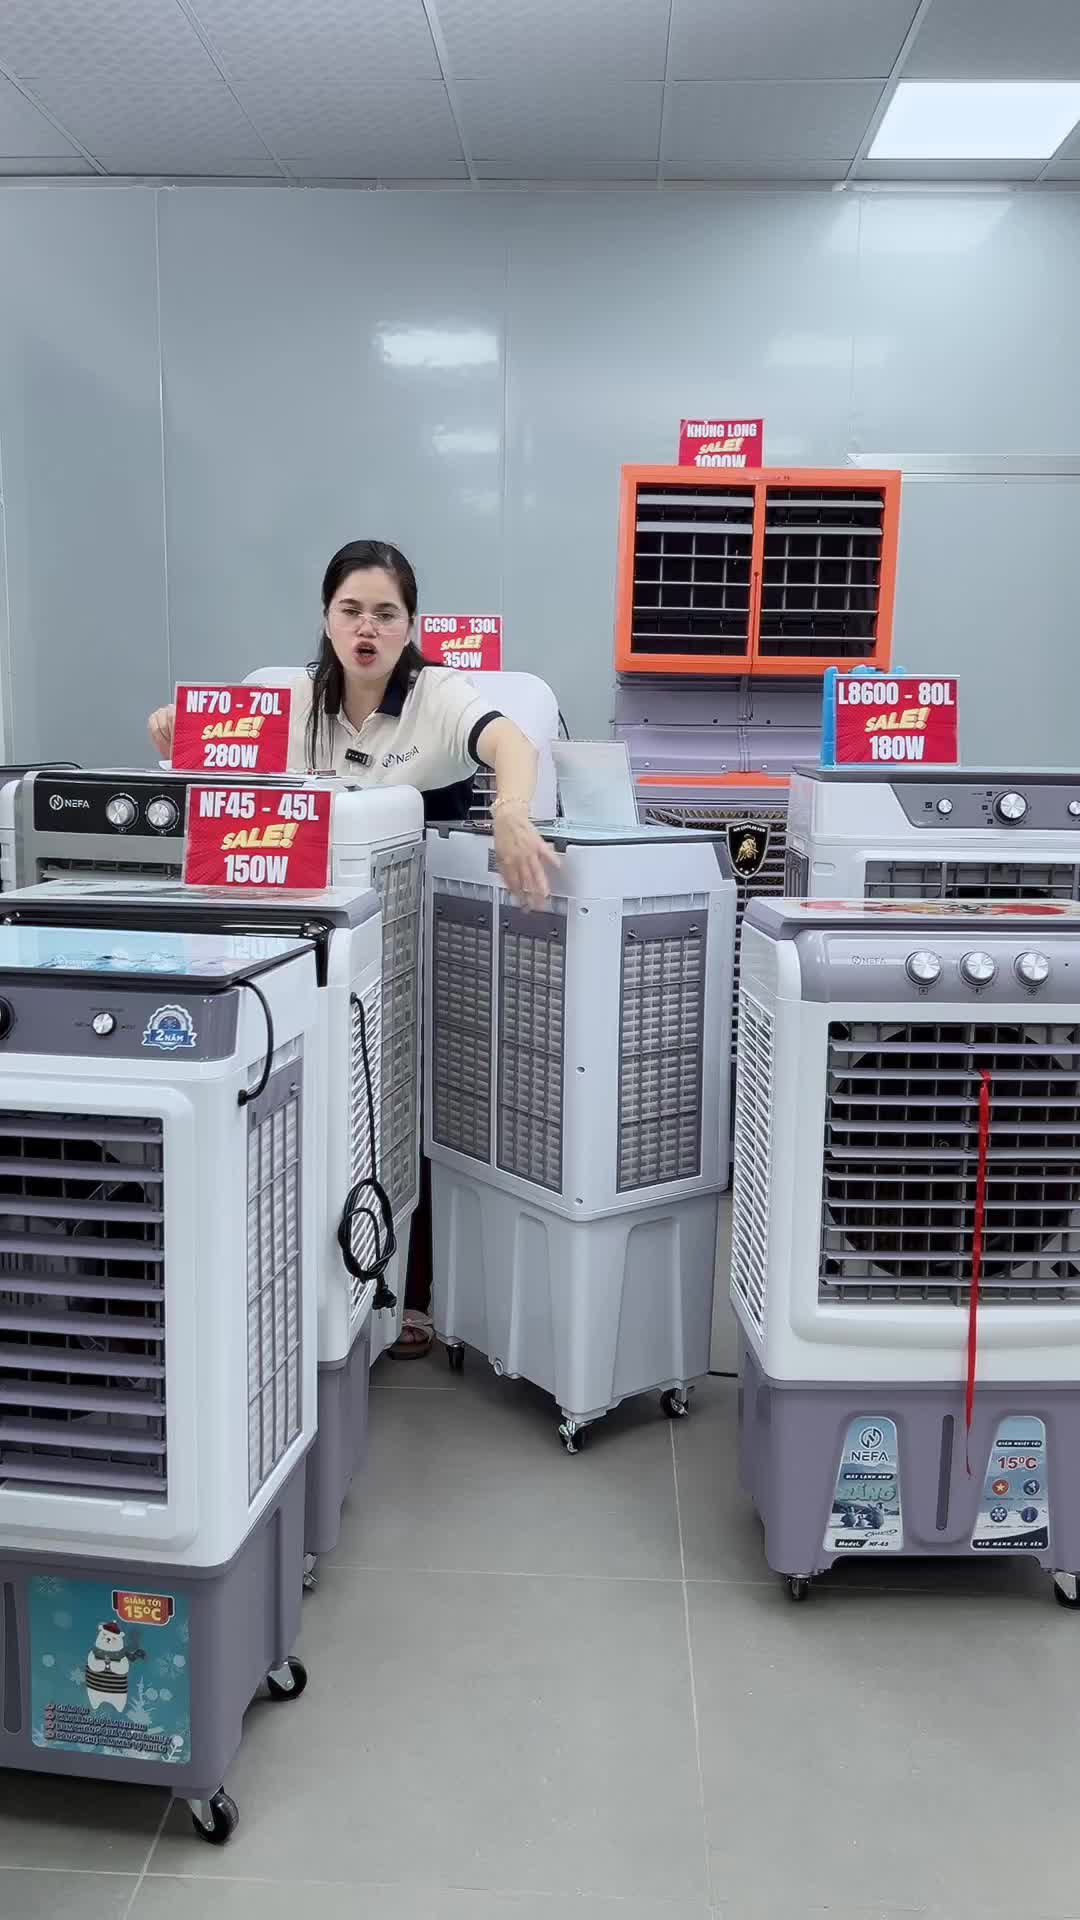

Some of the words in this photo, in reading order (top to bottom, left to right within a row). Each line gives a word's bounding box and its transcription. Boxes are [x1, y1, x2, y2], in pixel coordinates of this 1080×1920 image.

[687, 420, 724, 437] KHỦNG
[727, 423, 757, 437] LONG
[698, 437, 744, 454] SALE!
[424, 617, 457, 633] CC90
[468, 618, 498, 634] 130L
[440, 634, 483, 650] SALE!
[443, 651, 482, 668] 350W
[186, 690, 231, 714] NF70
[249, 691, 282, 715] 70L
[838, 681, 899, 705] L8600
[918, 682, 954, 705] 80L
[201, 715, 265, 740] SALE!
[864, 706, 931, 732] SALE!
[203, 743, 259, 768] 280W
[869, 735, 925, 760] 180W
[64, 799, 90, 808] NEFA
[200, 791, 256, 819] NF45
[277, 793, 319, 821] 45L
[221, 822, 299, 851] SALE!
[224, 854, 288, 884] 150W
[155, 1030, 164, 1042] 2
[851, 1451, 888, 1461] NEFA
